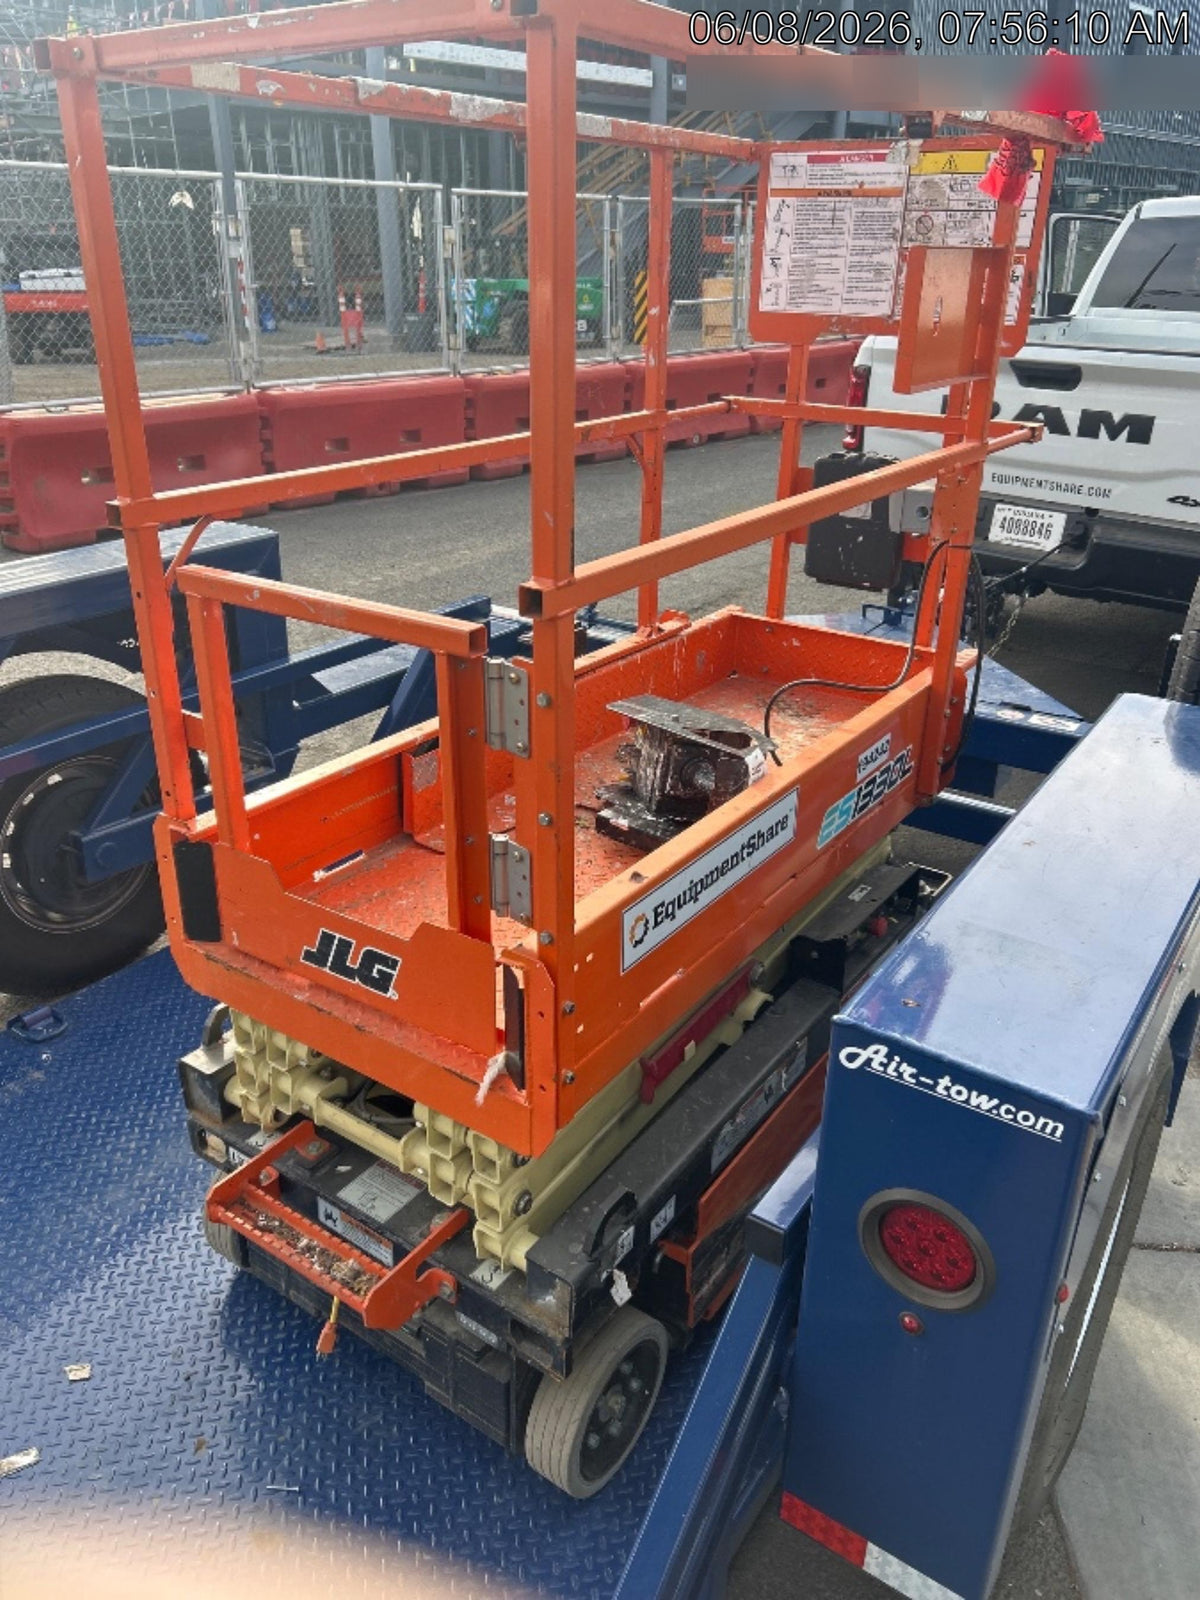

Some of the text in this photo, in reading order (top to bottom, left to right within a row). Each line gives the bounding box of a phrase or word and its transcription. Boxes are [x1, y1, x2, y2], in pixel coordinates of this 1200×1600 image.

[991, 472, 1112, 499] EQUIPMENTSHARE.COM
[651, 814, 790, 930] EquipmentShare
[301, 928, 402, 998] JLG
[838, 1044, 1065, 1140] Air-tow.com
